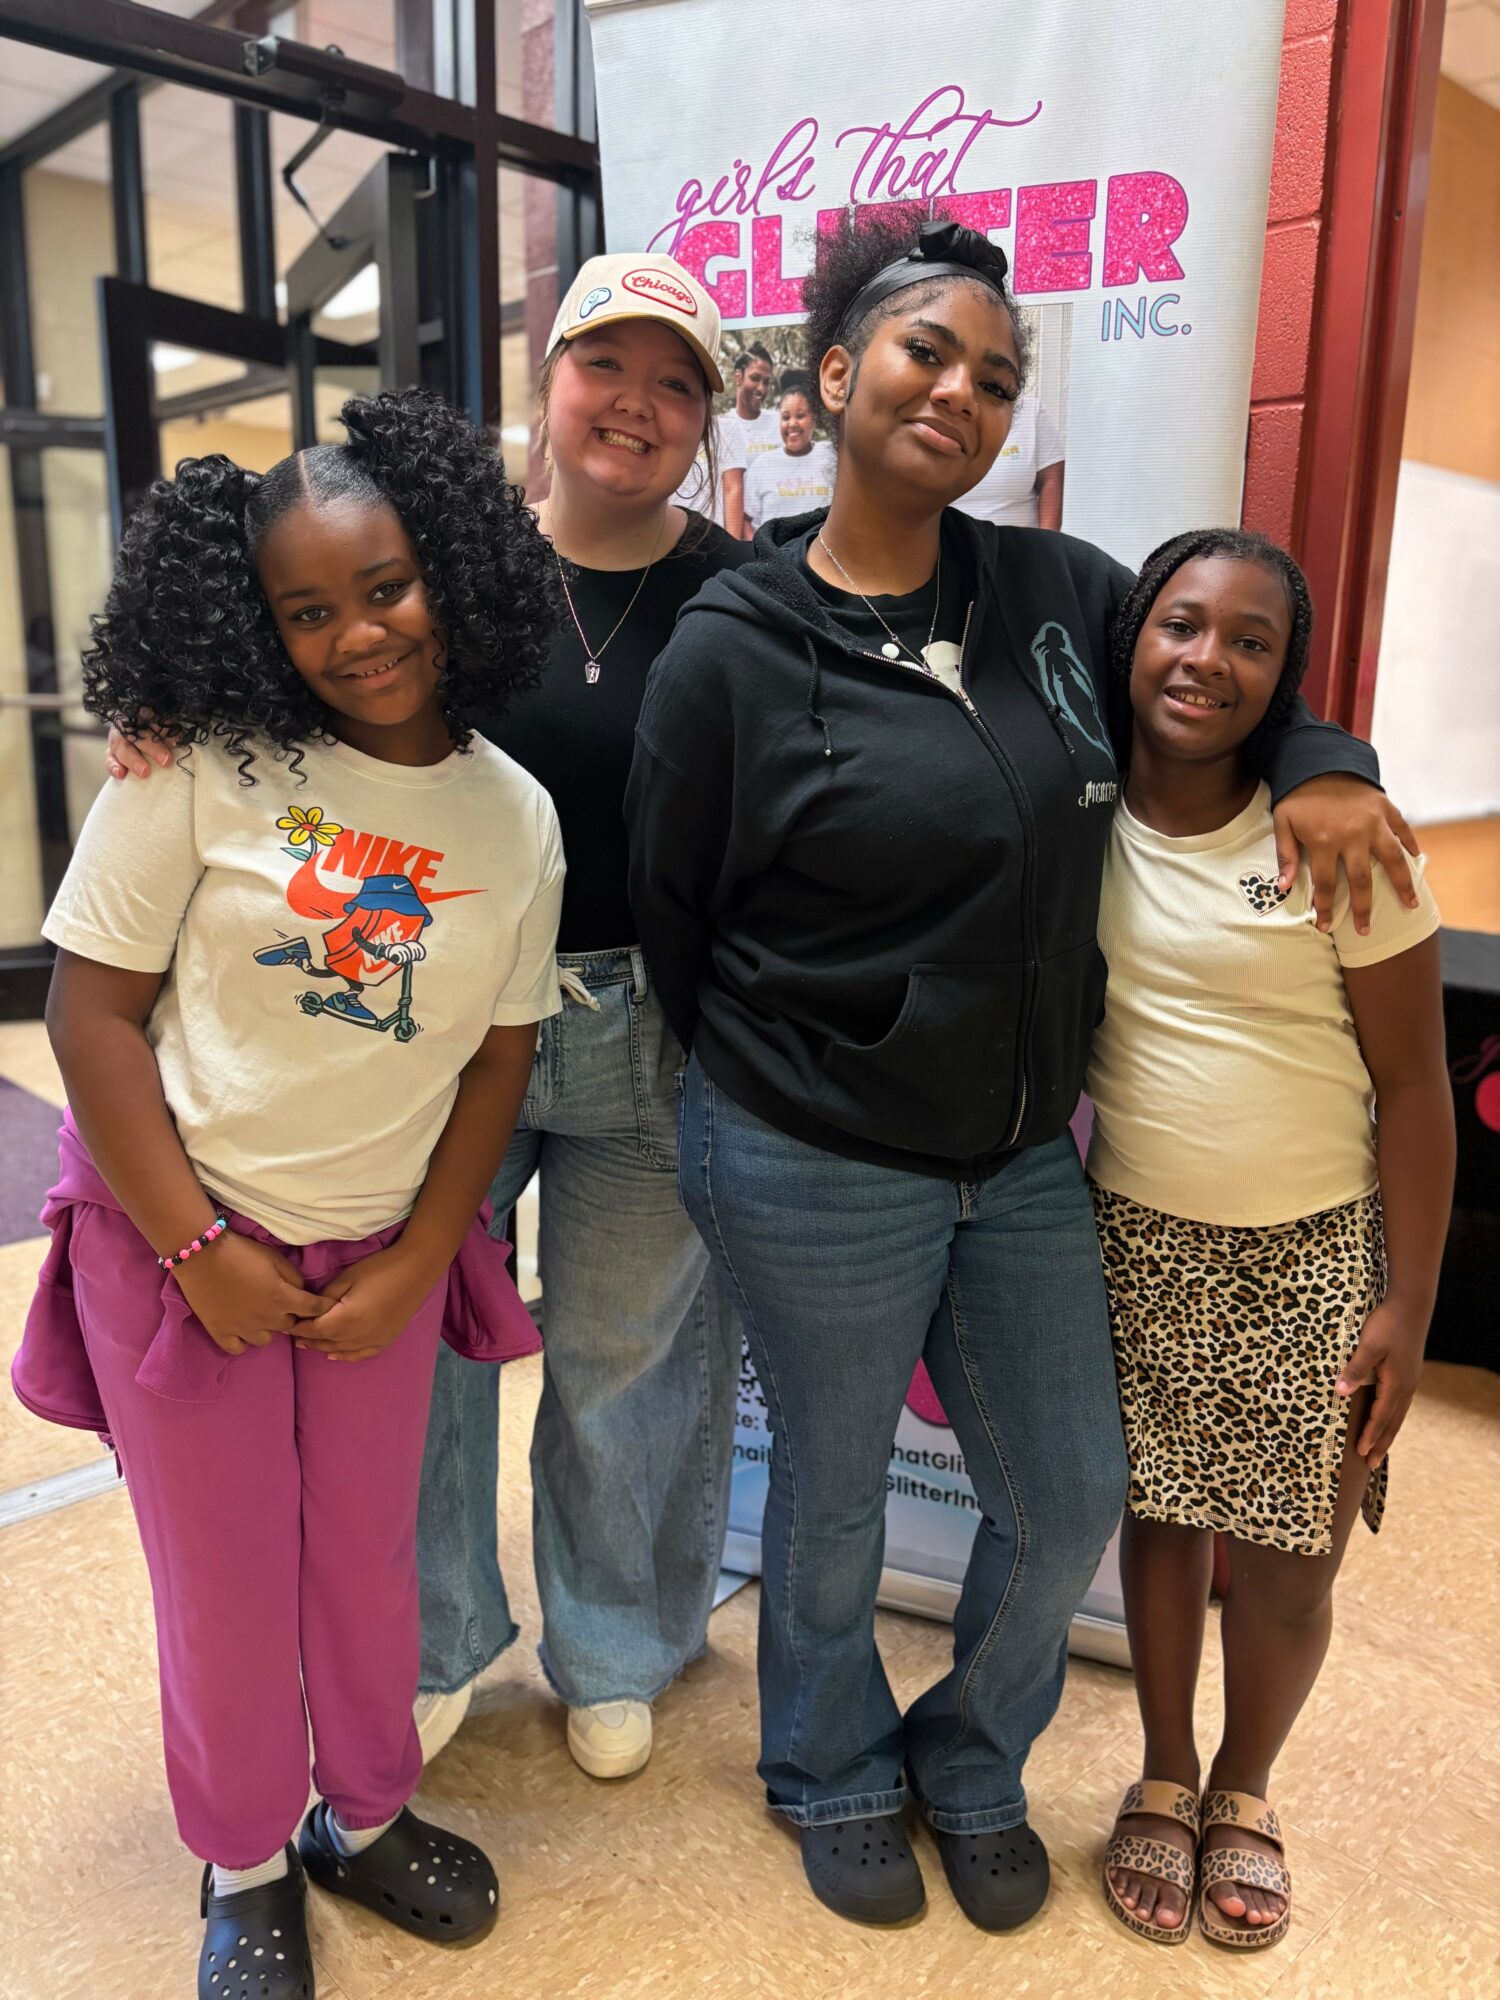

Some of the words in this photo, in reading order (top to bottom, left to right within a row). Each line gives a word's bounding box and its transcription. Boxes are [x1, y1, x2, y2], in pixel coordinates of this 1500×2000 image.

[645, 116, 819, 255] girls
[835, 85, 1042, 205] that
[631, 275, 694, 305] Chicago
[1101, 293, 1192, 342] INC.
[321, 828, 446, 894] NIKE
[890, 1442, 969, 1475] hatGli
[885, 1474, 981, 1511] GlitterIn
